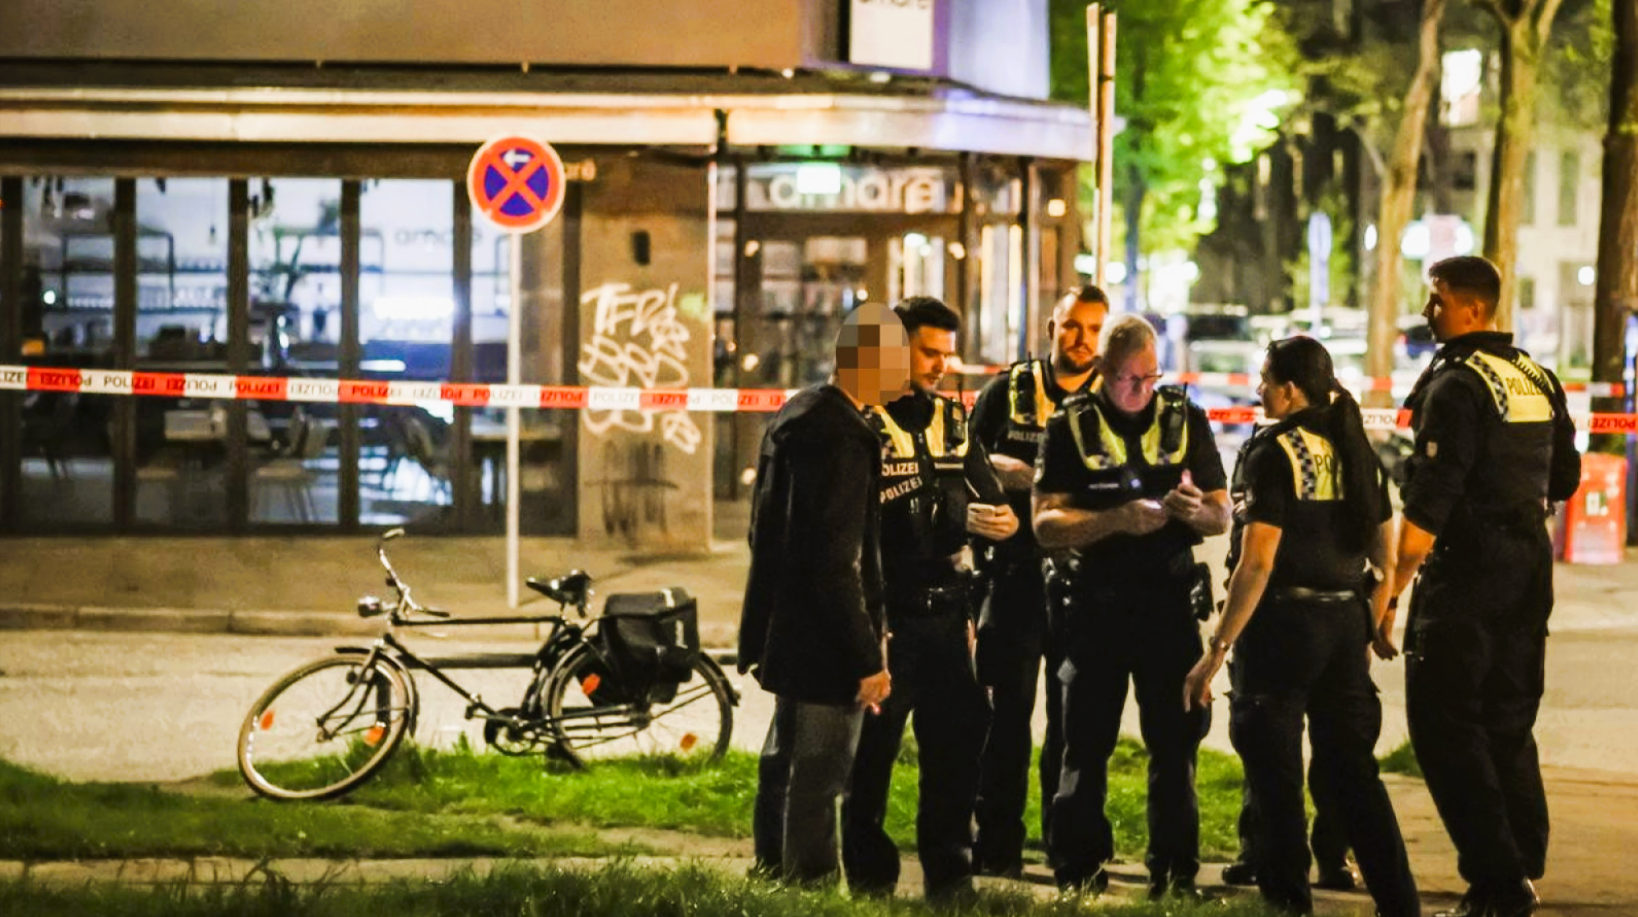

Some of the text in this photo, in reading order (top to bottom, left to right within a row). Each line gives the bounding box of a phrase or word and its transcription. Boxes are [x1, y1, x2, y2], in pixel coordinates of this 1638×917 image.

[40, 373, 92, 387] POLIZEI
[103, 376, 155, 389] POLIZEI
[166, 379, 217, 391] POLIZEI
[229, 382, 279, 393] POLIZEI
[351, 385, 402, 399] POLIZEI
